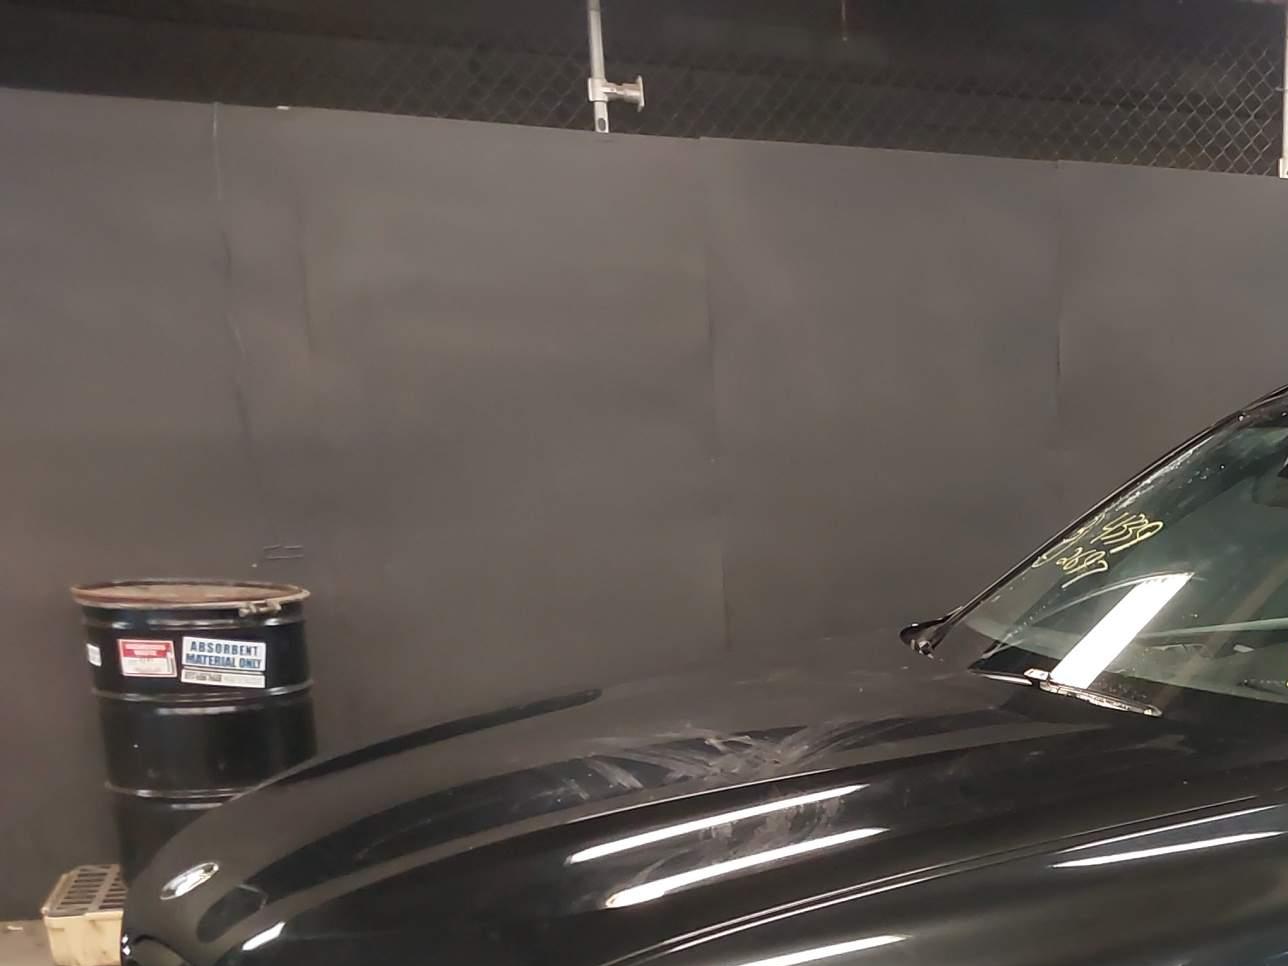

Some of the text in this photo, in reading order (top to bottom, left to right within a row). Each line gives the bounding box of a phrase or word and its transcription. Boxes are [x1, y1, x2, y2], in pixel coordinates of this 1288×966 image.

[190, 641, 259, 656] ABSORBENT
[185, 653, 262, 669] MATERIAL ONLY
